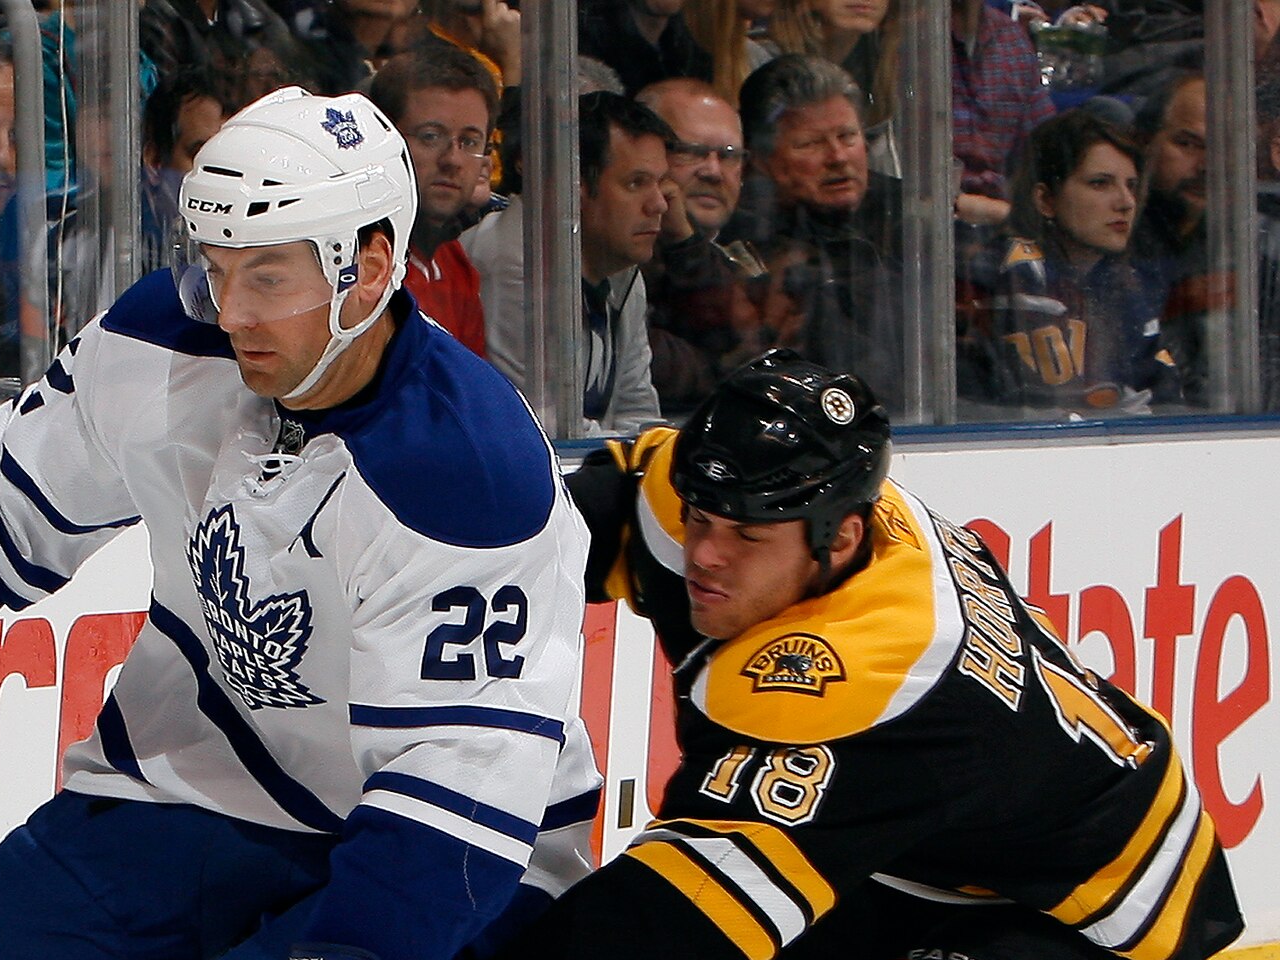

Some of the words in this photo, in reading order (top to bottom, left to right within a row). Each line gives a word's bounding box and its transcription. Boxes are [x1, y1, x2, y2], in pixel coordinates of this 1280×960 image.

[186, 197, 233, 215] CCM
[419, 584, 529, 681] 22
[216, 646, 278, 690] EAFS
[751, 638, 834, 672] BRUINS
[699, 744, 836, 827] 18
